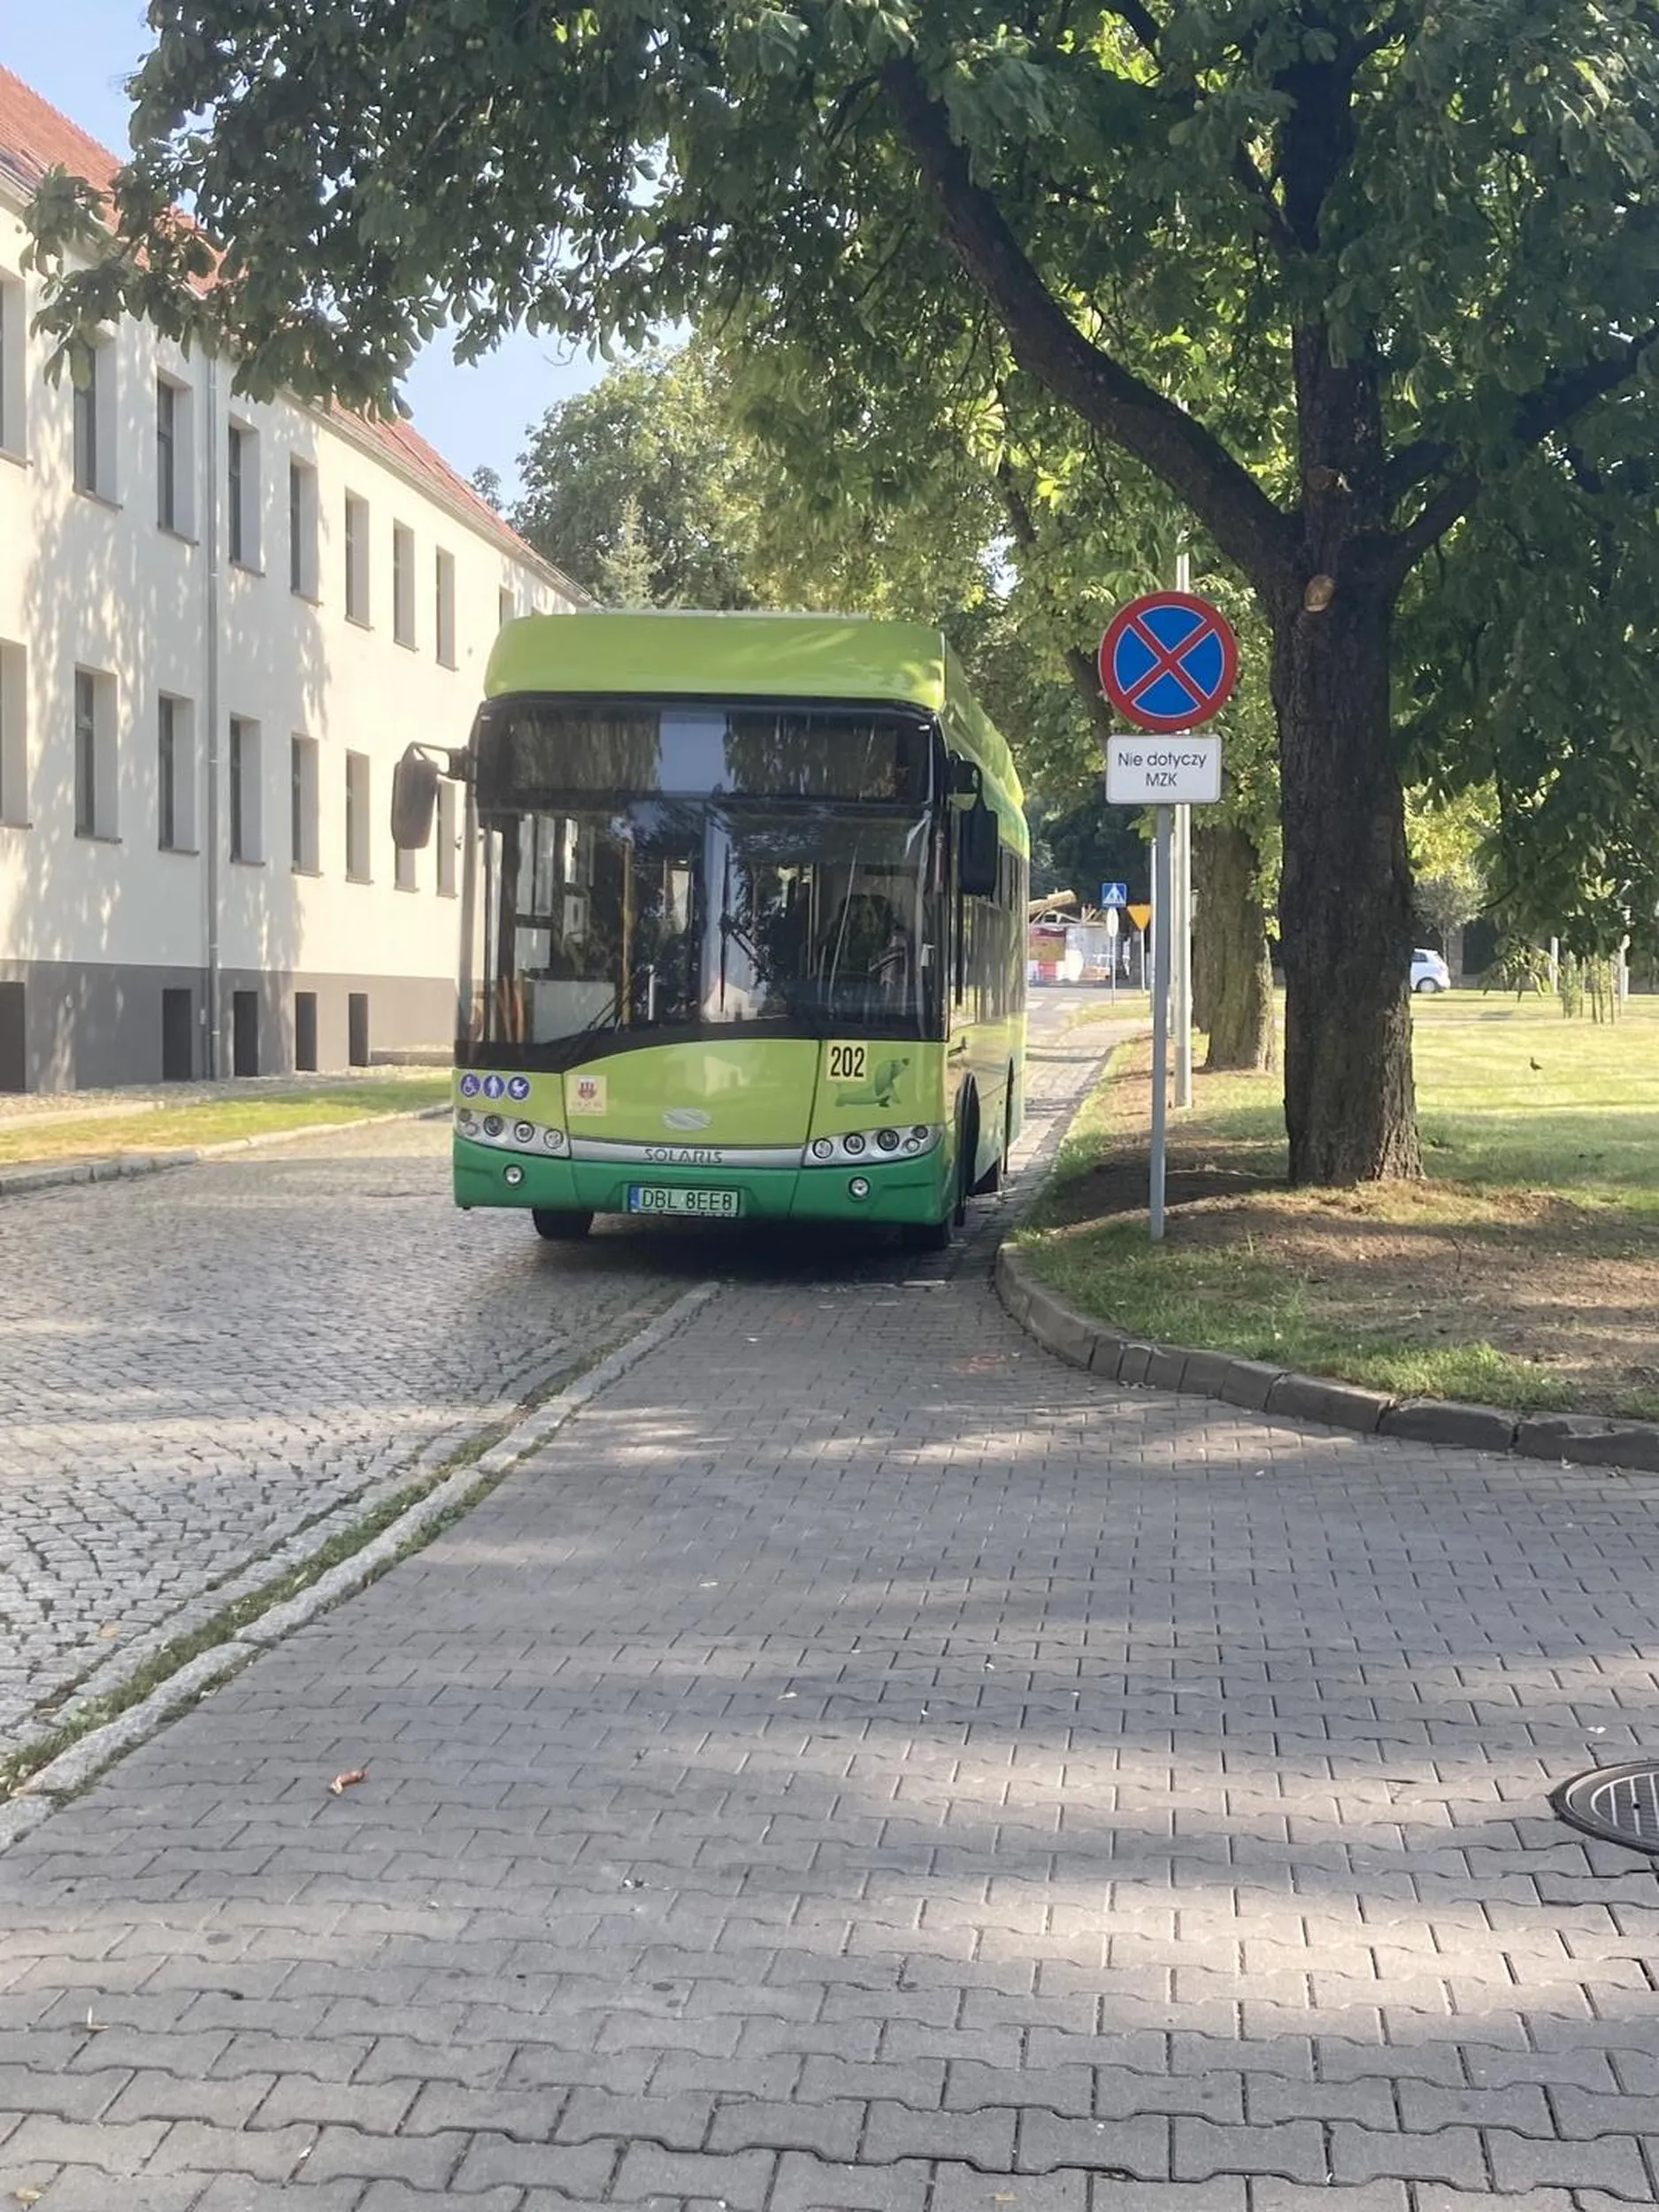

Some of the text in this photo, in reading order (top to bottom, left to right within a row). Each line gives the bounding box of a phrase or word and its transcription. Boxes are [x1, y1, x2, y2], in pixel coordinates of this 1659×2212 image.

[1118, 752, 1207, 769] Nie dotyczy
[1145, 772, 1178, 787] MZK
[830, 1046, 865, 1078] 202
[643, 1148, 723, 1164] SOLARIS
[641, 1189, 733, 1211] DBL 8EE8
